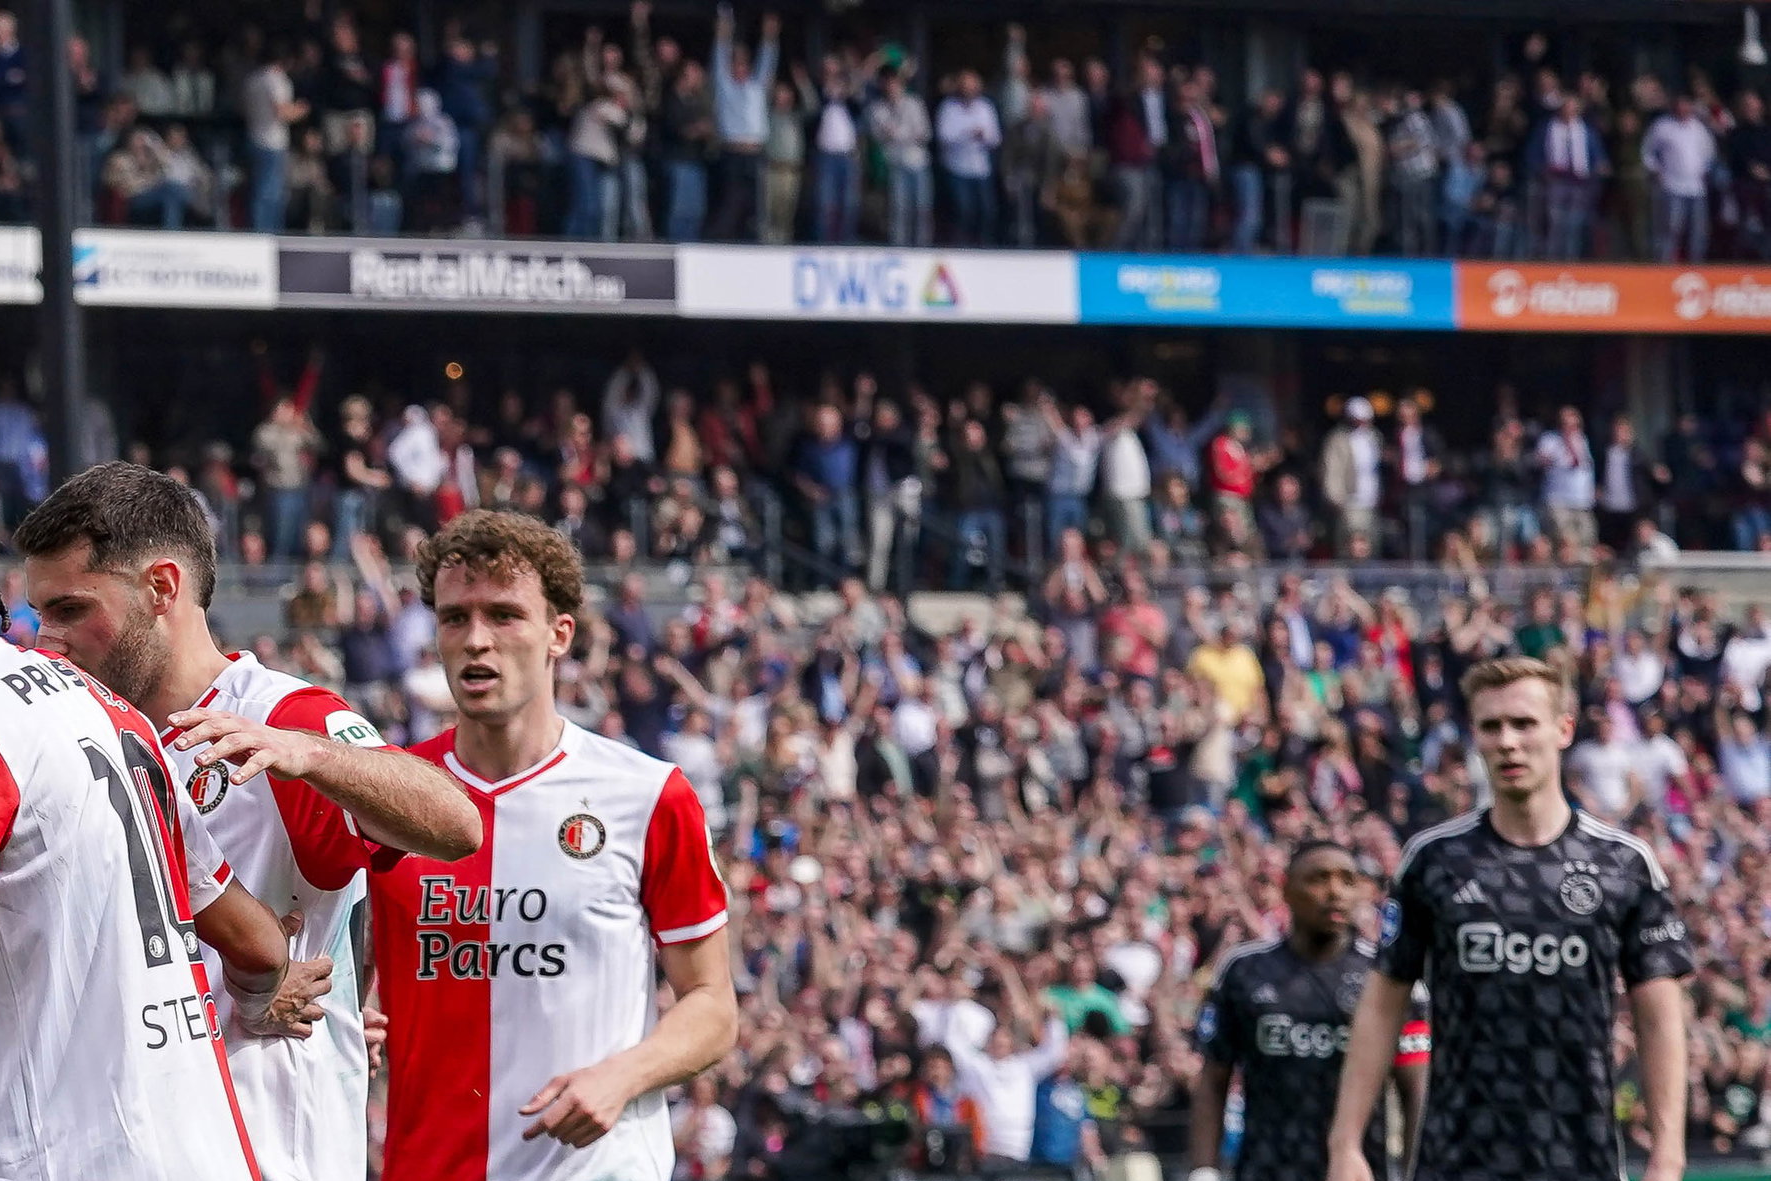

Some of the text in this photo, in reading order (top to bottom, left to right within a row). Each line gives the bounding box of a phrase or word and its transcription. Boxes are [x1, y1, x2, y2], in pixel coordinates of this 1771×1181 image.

[792, 256, 910, 306] DWG
[417, 874, 548, 925] Euro
[416, 931, 567, 980] Parcs
